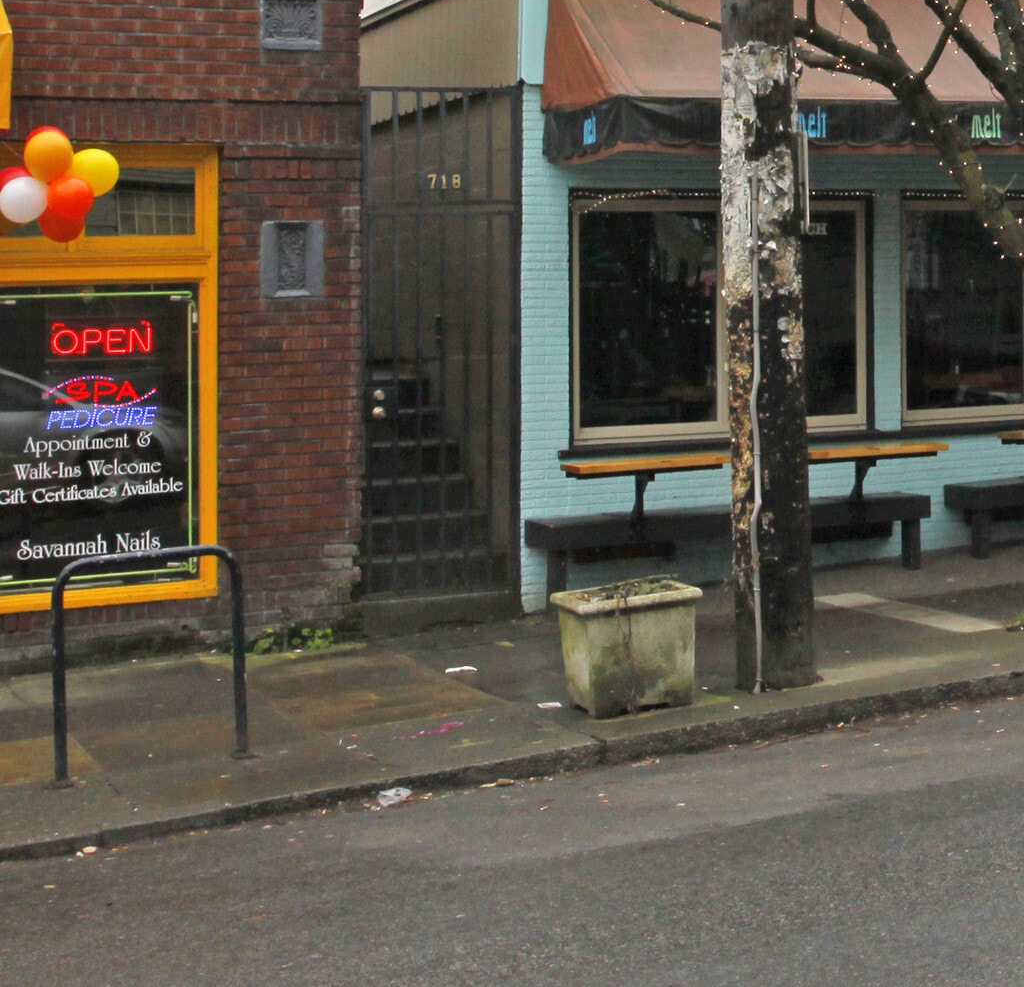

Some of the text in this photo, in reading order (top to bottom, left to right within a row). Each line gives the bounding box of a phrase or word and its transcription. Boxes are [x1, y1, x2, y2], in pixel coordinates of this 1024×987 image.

[970, 107, 1002, 139] melt
[426, 173, 462, 190] 718
[51, 326, 153, 357] OPEN
[55, 380, 142, 406] SPA
[46, 406, 158, 430] PEDICURE
[23, 430, 153, 458] Appointment &
[13, 458, 162, 481] Walk-Ins Welcome
[0, 476, 184, 505] Gift Certificates Available
[16, 529, 161, 561] Savannah Nails
